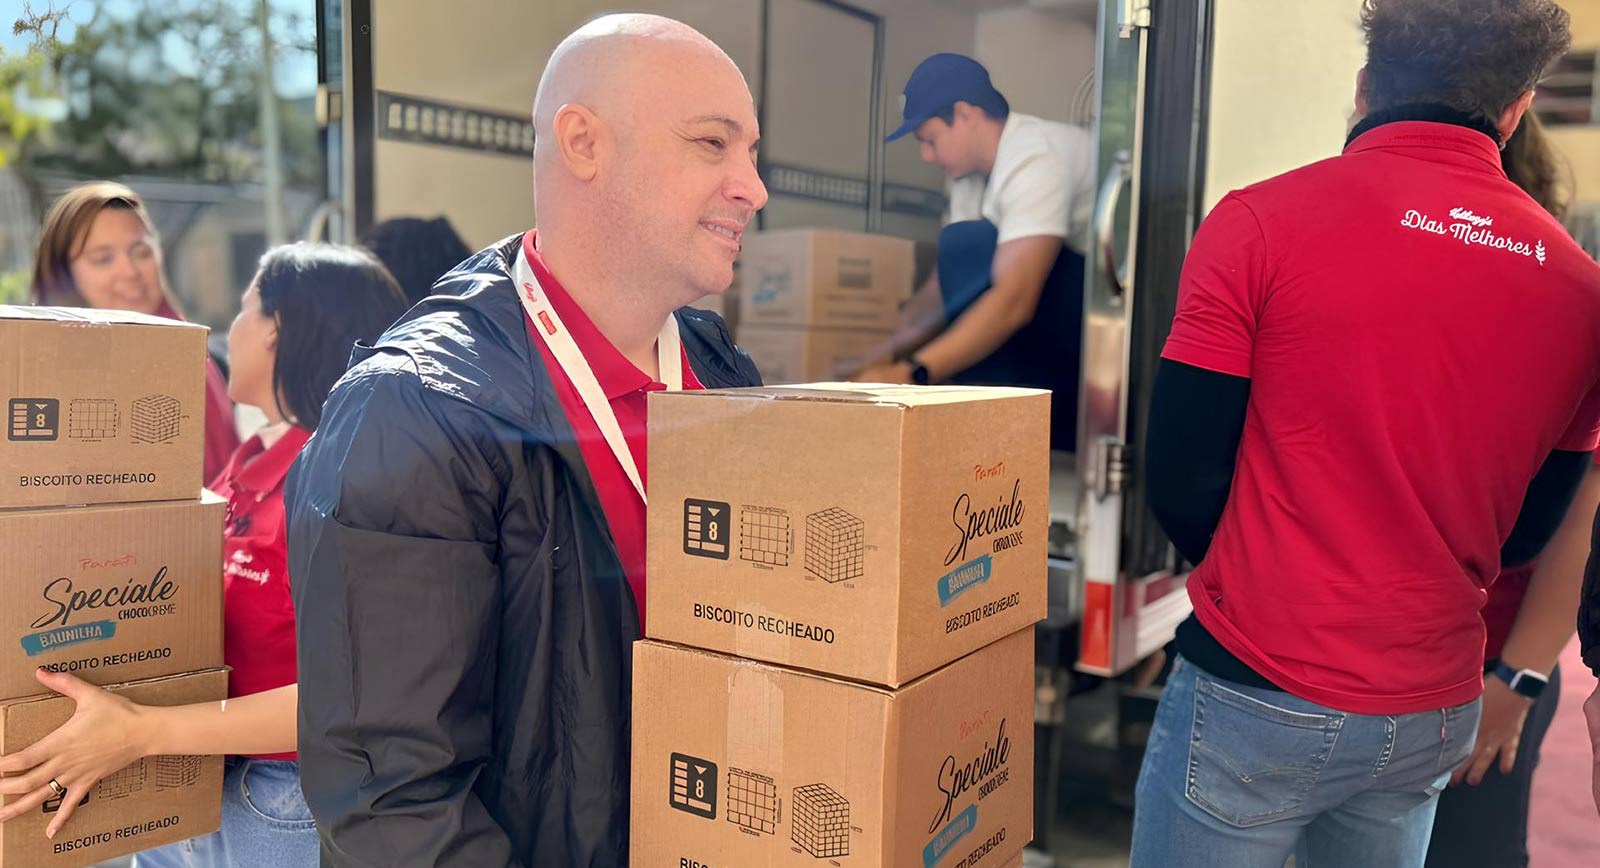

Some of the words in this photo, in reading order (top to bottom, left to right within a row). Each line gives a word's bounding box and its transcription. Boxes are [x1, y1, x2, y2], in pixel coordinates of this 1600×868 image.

[1450, 223, 1533, 256] Melhores
[36, 413, 46, 427] 8
[20, 475, 82, 486] BISCOITO
[86, 473, 156, 485] RECHEADO
[708, 521, 718, 541] 8
[944, 478, 1025, 566] Speciale
[30, 566, 179, 629] Speciale
[694, 603, 754, 628] BISCOITO
[757, 615, 835, 644] RECHEADO
[39, 624, 104, 648] BAUNILHA
[103, 647, 171, 667] RECHEADO
[929, 718, 1011, 834] Speciale
[695, 779, 704, 798] 8
[53, 832, 111, 854] BISCOITO
